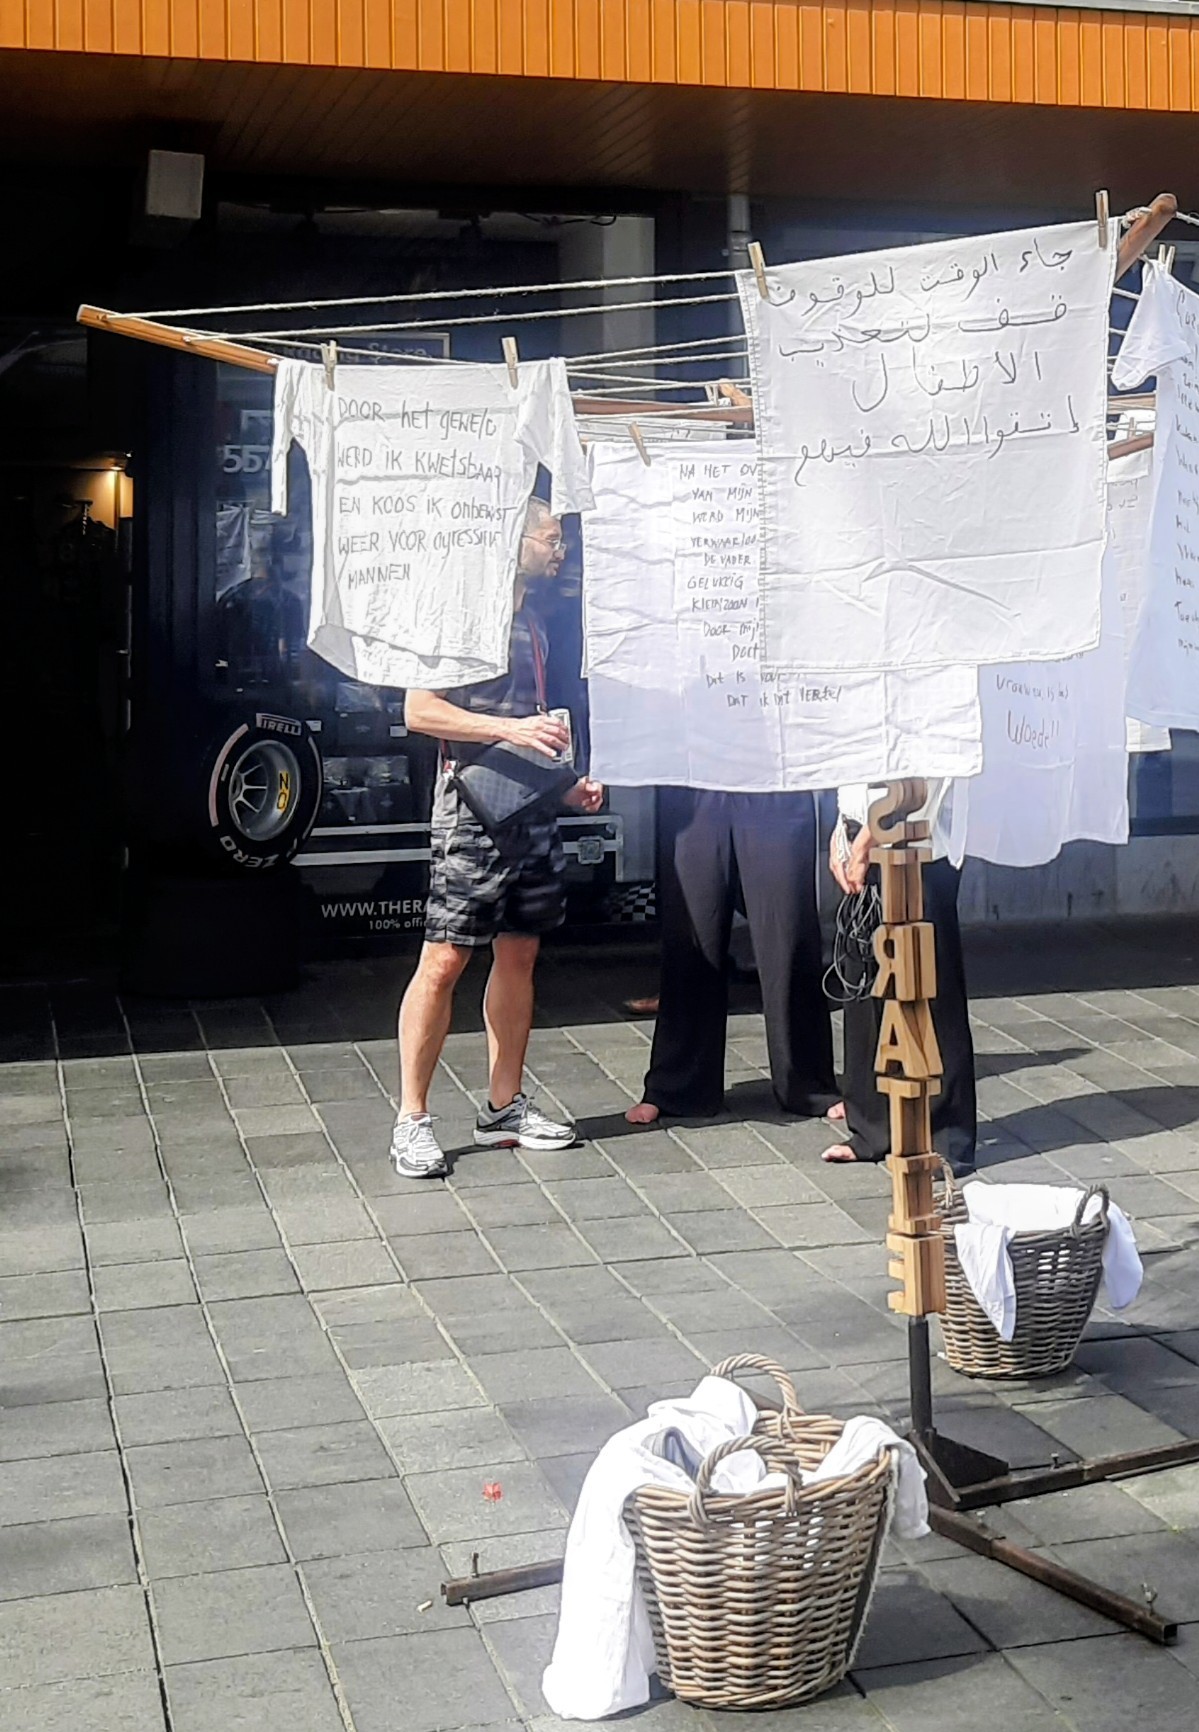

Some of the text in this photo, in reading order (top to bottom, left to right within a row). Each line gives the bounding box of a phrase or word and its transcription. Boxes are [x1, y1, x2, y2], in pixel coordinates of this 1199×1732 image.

[768, 237, 1073, 320] جاء الوقت للوقوف
[957, 294, 1067, 333] قف
[338, 397, 386, 423] DOOR
[337, 442, 373, 469] WERD
[680, 463, 758, 480] NA HET OV
[339, 496, 361, 515] EN
[372, 495, 418, 516] KOOS
[338, 531, 380, 556] WEER
[388, 529, 427, 553] VOOR
[347, 563, 411, 590] MANNEN
[256, 713, 302, 736] PIRELLI
[219, 835, 280, 869] ZERO
[369, 919, 401, 930] 100%
